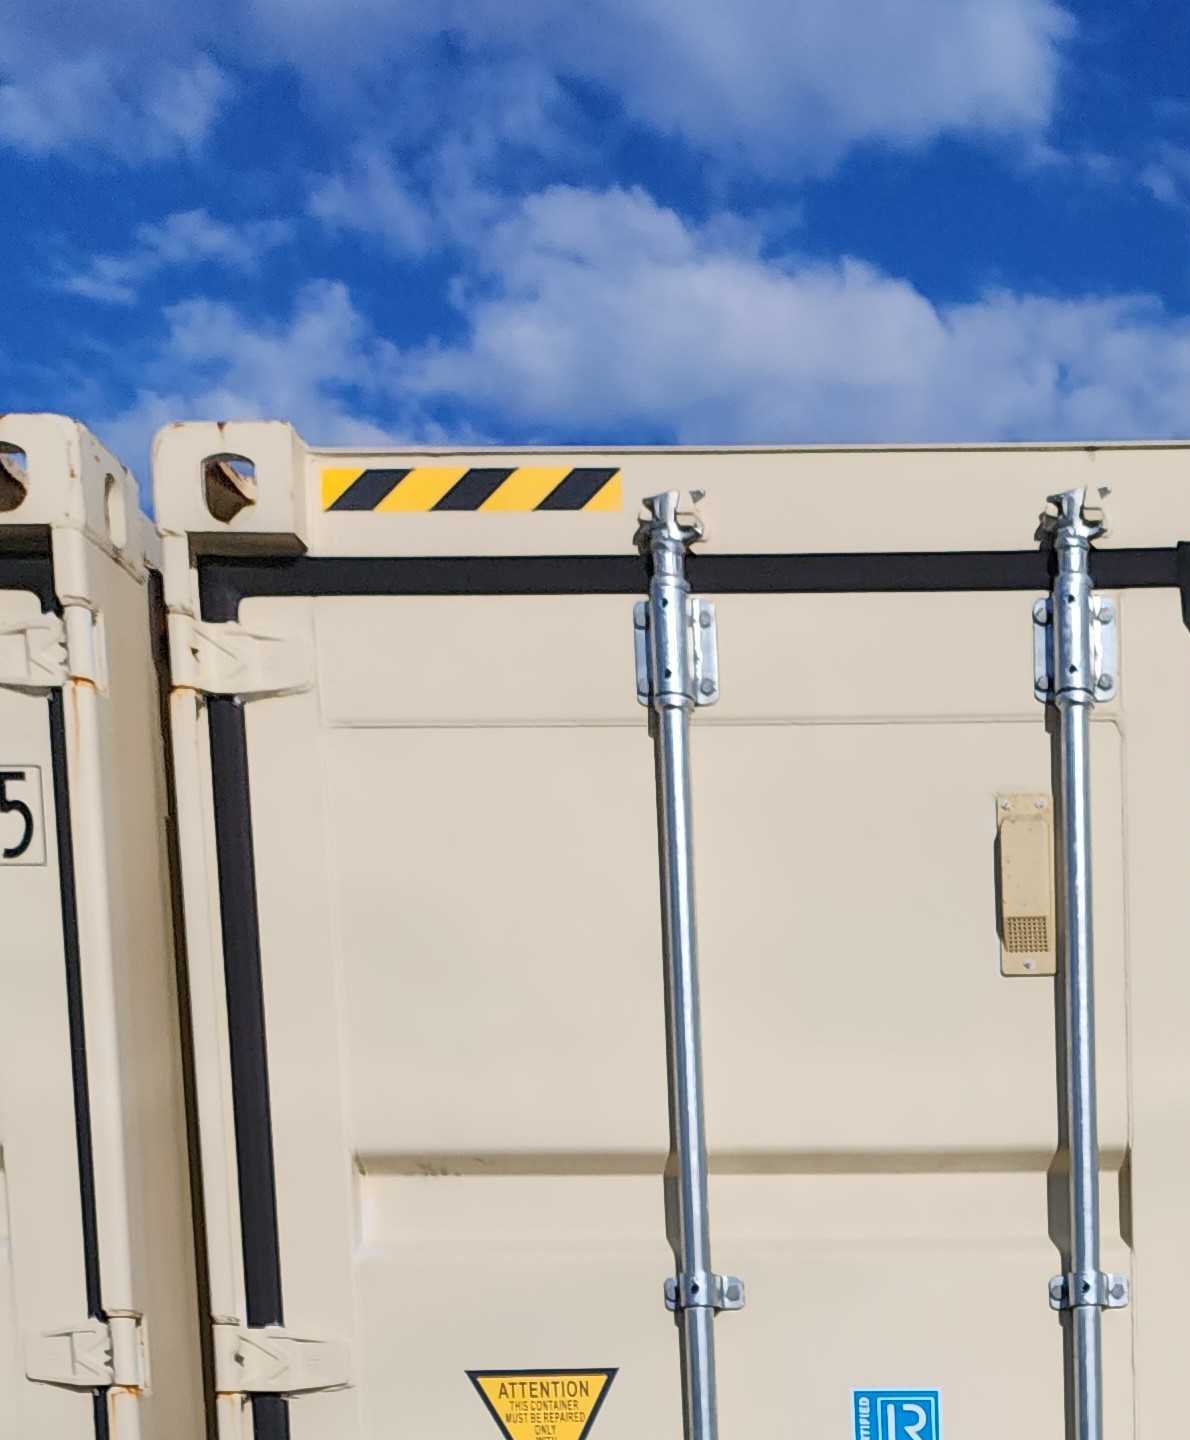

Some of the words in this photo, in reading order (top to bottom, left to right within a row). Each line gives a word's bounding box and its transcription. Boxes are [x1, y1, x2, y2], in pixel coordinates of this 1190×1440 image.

[0, 771, 34, 859] 5
[498, 1380, 590, 1399] ATTENTION
[509, 1401, 529, 1411] THIS
[531, 1400, 579, 1410] CONTAINER
[505, 1413, 528, 1423] MUST
[530, 1413, 543, 1423] BE
[543, 1412, 586, 1423] REPAIRED
[534, 1425, 557, 1435] ONLY
